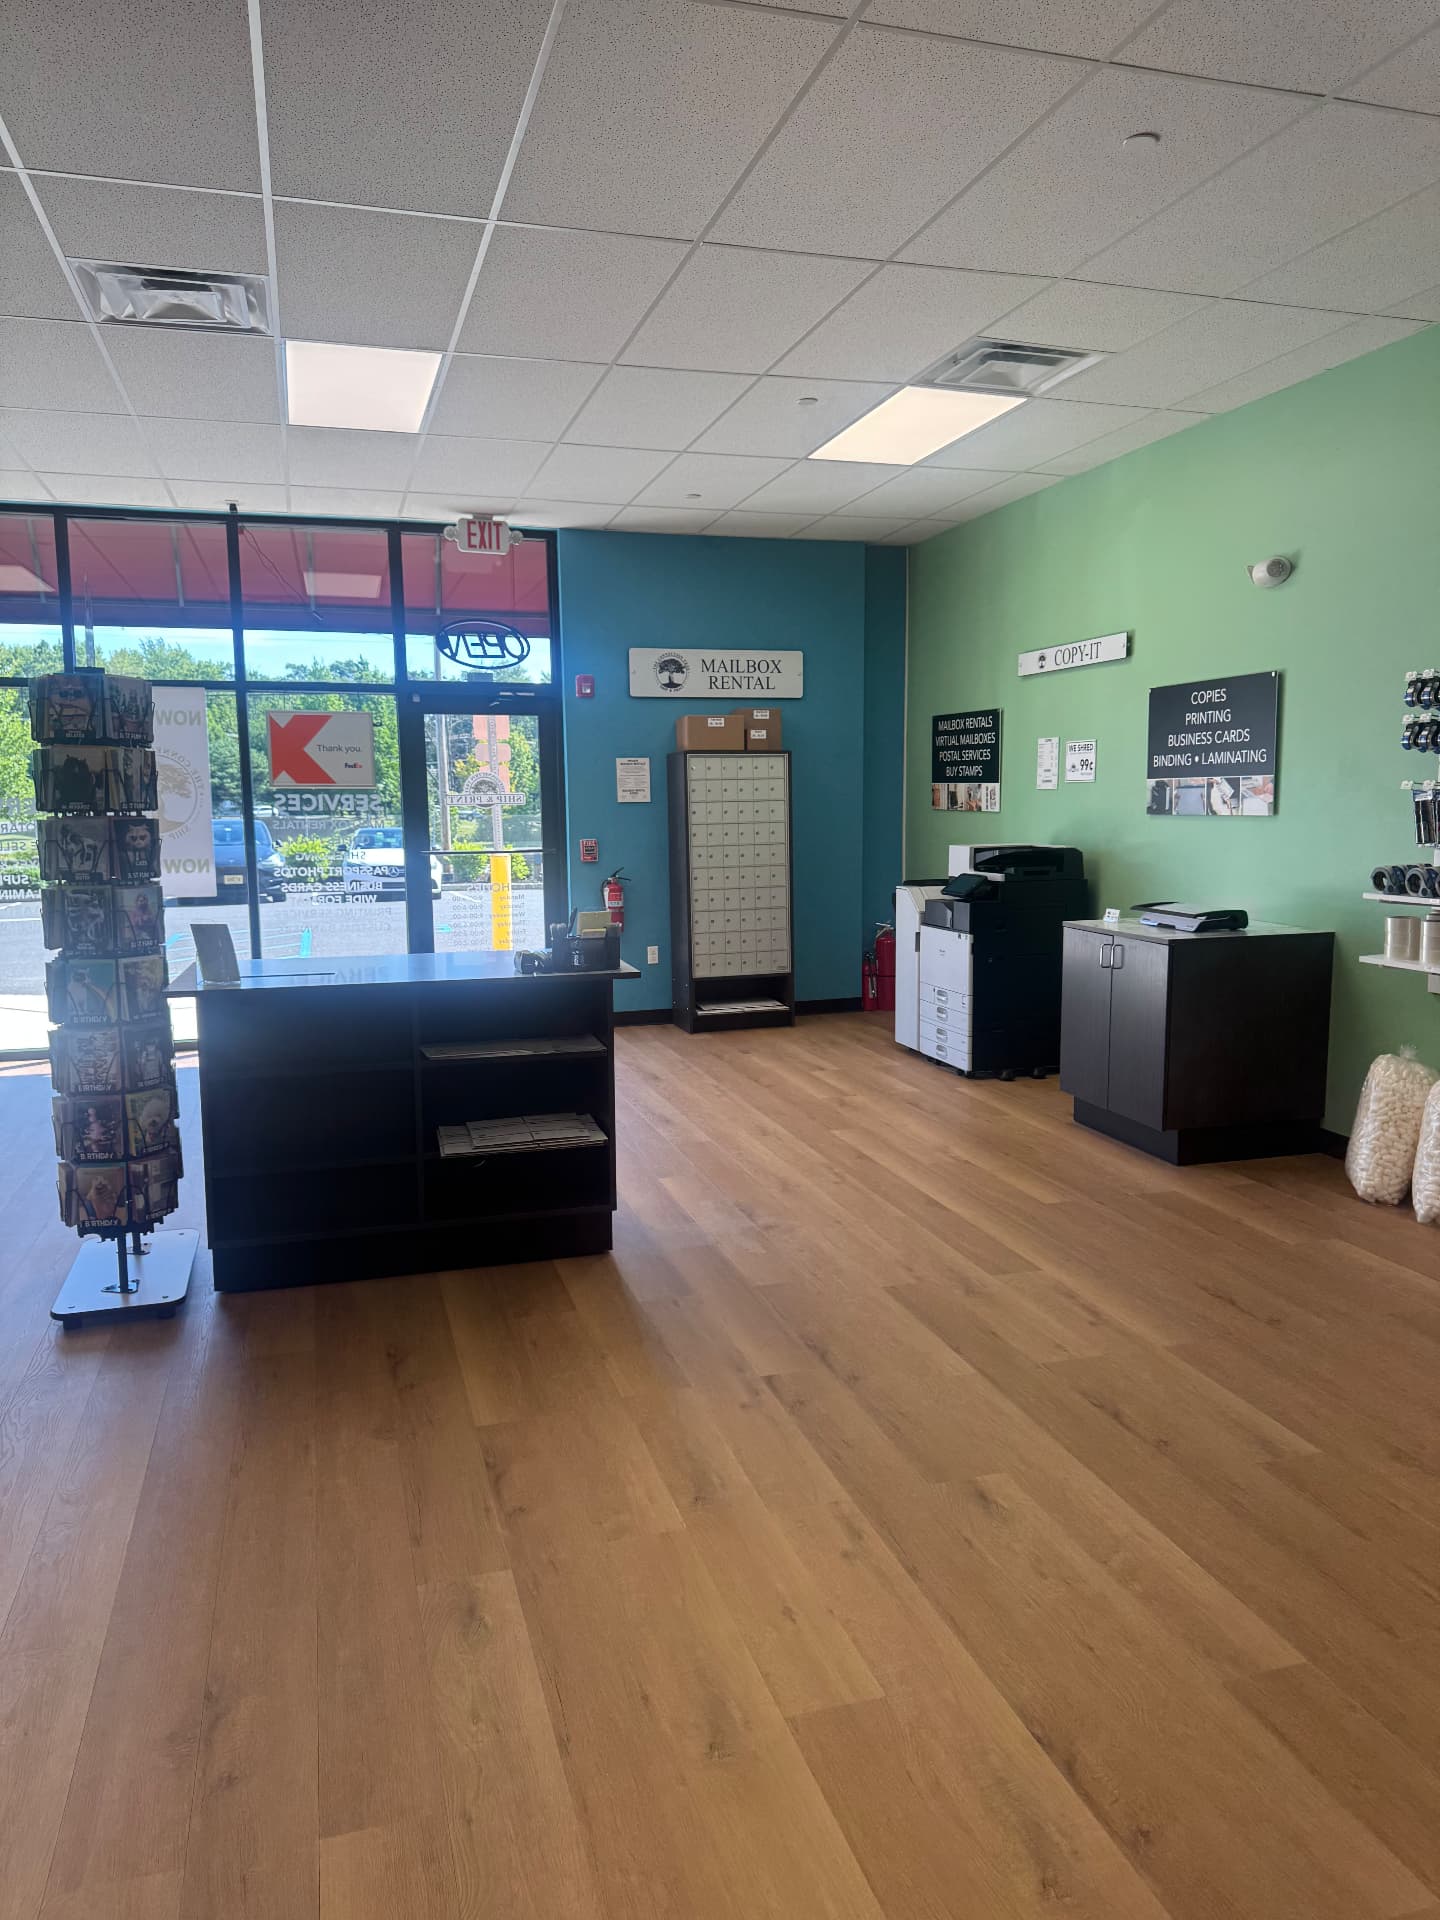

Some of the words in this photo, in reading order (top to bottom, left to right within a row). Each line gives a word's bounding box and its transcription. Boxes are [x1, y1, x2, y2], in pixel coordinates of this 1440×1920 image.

[467, 520, 503, 551] EXIT
[1054, 642, 1102, 666] COPY-IT
[702, 658, 783, 673] MAILBOX
[709, 675, 776, 690] RENTAL
[1191, 688, 1227, 704] COPIES
[938, 718, 965, 731] MAILBOX
[966, 716, 993, 729] RENTALS
[1185, 709, 1231, 725] PRINTING
[936, 735, 959, 747] VIRTUAL
[960, 733, 996, 746] MAILBOXES
[1168, 731, 1212, 747] BUSINESS
[1215, 729, 1250, 743] CARDS
[317, 744, 343, 753] Thank
[939, 751, 961, 762] POSTAL
[962, 749, 991, 761] SERVICES
[1069, 744, 1077, 753] WE
[1078, 743, 1094, 753] SHRED
[1080, 758, 1094, 771] 99¢
[1153, 753, 1192, 767] BINDING
[1202, 749, 1267, 765] LAMINATING
[946, 766, 958, 777] BUY
[959, 765, 983, 777] STAMPS
